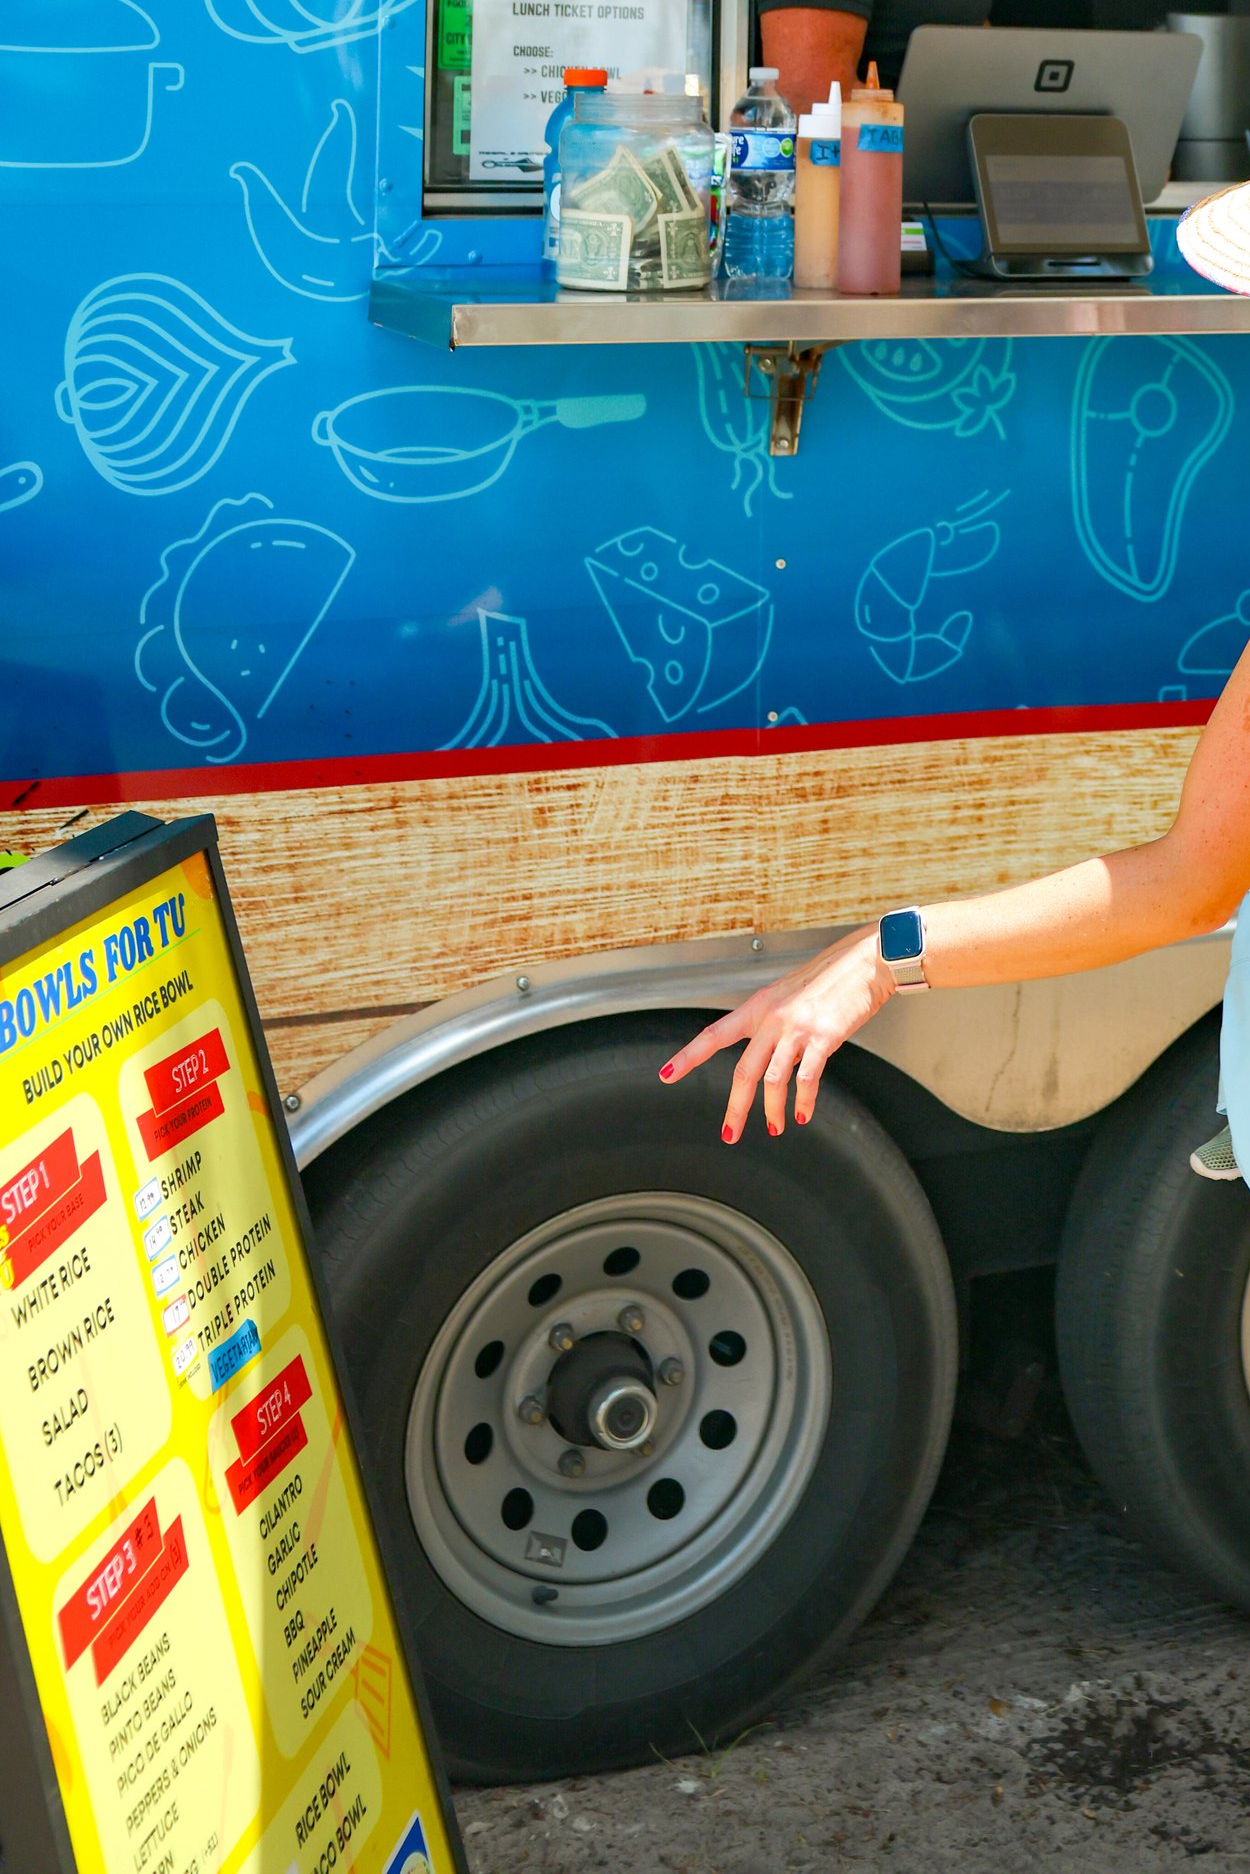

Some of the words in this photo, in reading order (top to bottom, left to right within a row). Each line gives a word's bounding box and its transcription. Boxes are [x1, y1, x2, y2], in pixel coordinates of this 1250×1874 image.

[512, 2, 550, 16] LUNCH
[555, 4, 592, 18] TICKET
[597, 6, 644, 20] OPTIONS
[513, 46, 554, 58] CHOOSE:
[0, 948, 97, 1054] BOWLS
[103, 916, 154, 983] FOR
[153, 892, 185, 948] TU
[22, 1059, 64, 1105] BUILD
[63, 1033, 103, 1074] YOUR
[102, 1010, 135, 1048] OWN
[134, 991, 161, 1028] RICE
[160, 970, 194, 1010] BOWL
[171, 1052, 200, 1093] STEP
[199, 1049, 210, 1075] 2
[154, 1126, 170, 1142] PICK
[169, 1116, 187, 1135] YOUR
[187, 1096, 213, 1124] PROTEIN
[1, 1168, 39, 1224] STEP
[39, 1160, 50, 1189] 1
[161, 1151, 203, 1200] SHRIMP
[28, 1230, 45, 1253] PICK
[45, 1208, 67, 1236] YOUR
[66, 1193, 85, 1217] BASE
[169, 1191, 205, 1235] STEAK
[179, 1212, 226, 1270] CHICKEN
[11, 1273, 59, 1329] WHITE
[58, 1247, 91, 1292] RICE
[187, 1255, 231, 1310] DOUBLE
[230, 1213, 272, 1267] PROTEIN
[197, 1303, 234, 1352] TRIPLE
[234, 1259, 276, 1316] PROTEIN
[28, 1326, 84, 1393] BROWN
[83, 1298, 115, 1343] RICE
[210, 1328, 260, 1383] VEGETARIAN
[42, 1388, 89, 1447] SALAD
[256, 1389, 283, 1435] STEP
[283, 1381, 292, 1405] 4
[54, 1443, 105, 1507] TACOS
[104, 1422, 123, 1462] (3)
[259, 1474, 303, 1540] CILANTRO
[86, 1553, 124, 1621] STEP
[122, 1539, 137, 1575] 3
[267, 1522, 301, 1576] GARLIC
[276, 1543, 318, 1611] CHIPOTLE
[284, 1610, 305, 1648] BBQ
[292, 1607, 338, 1685] PINEAPPLE
[100, 1675, 137, 1727] BLACK
[137, 1632, 171, 1683] BEANS
[301, 1671, 328, 1719] SOUR
[325, 1627, 356, 1682] CREAM
[109, 1710, 143, 1763] PINTO
[143, 1668, 176, 1720] BEANS
[117, 1753, 145, 1799] PICO
[147, 1731, 161, 1762] DE
[160, 1690, 193, 1742] GALLO
[126, 1769, 171, 1838] PEPPERS
[171, 1758, 179, 1778] &
[178, 1706, 217, 1768] ONIONS
[295, 1794, 322, 1850] RICE
[318, 1751, 351, 1812] BOWL
[133, 1799, 180, 1874] LETTUCE
[335, 1794, 367, 1855] BOWL
